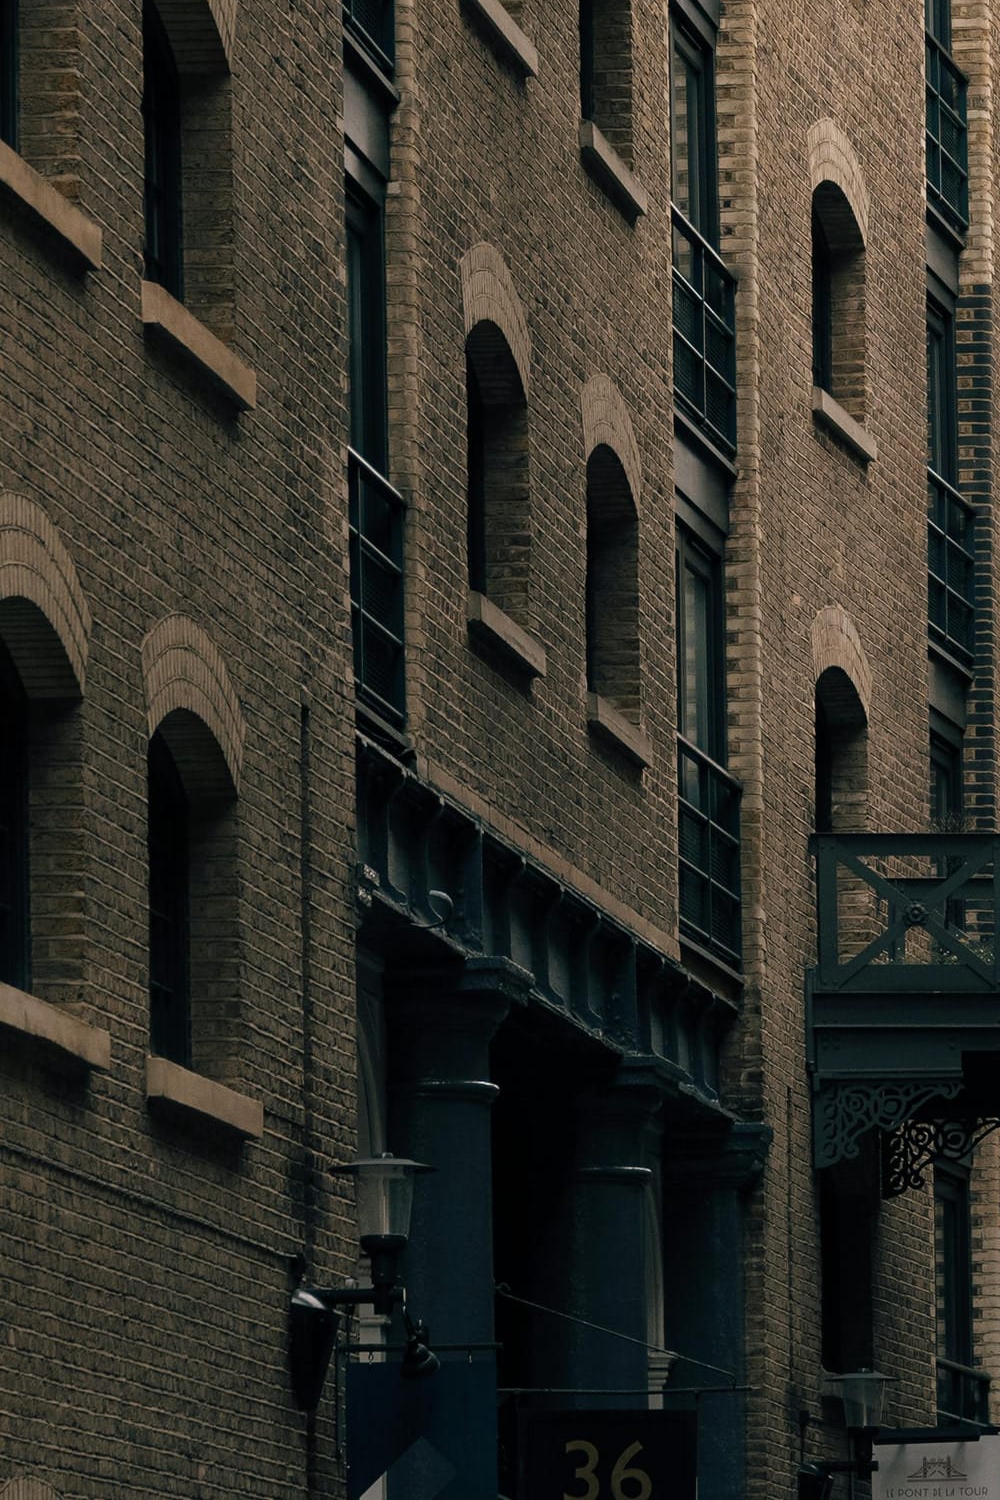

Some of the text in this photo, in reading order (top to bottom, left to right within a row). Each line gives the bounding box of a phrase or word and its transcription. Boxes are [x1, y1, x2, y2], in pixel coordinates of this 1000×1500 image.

[562, 1438, 653, 1500] 36
[898, 1488, 928, 1498] PONT
[933, 1487, 941, 1497] DE
[945, 1487, 955, 1497] LA
[960, 1486, 988, 1497] TOUR
